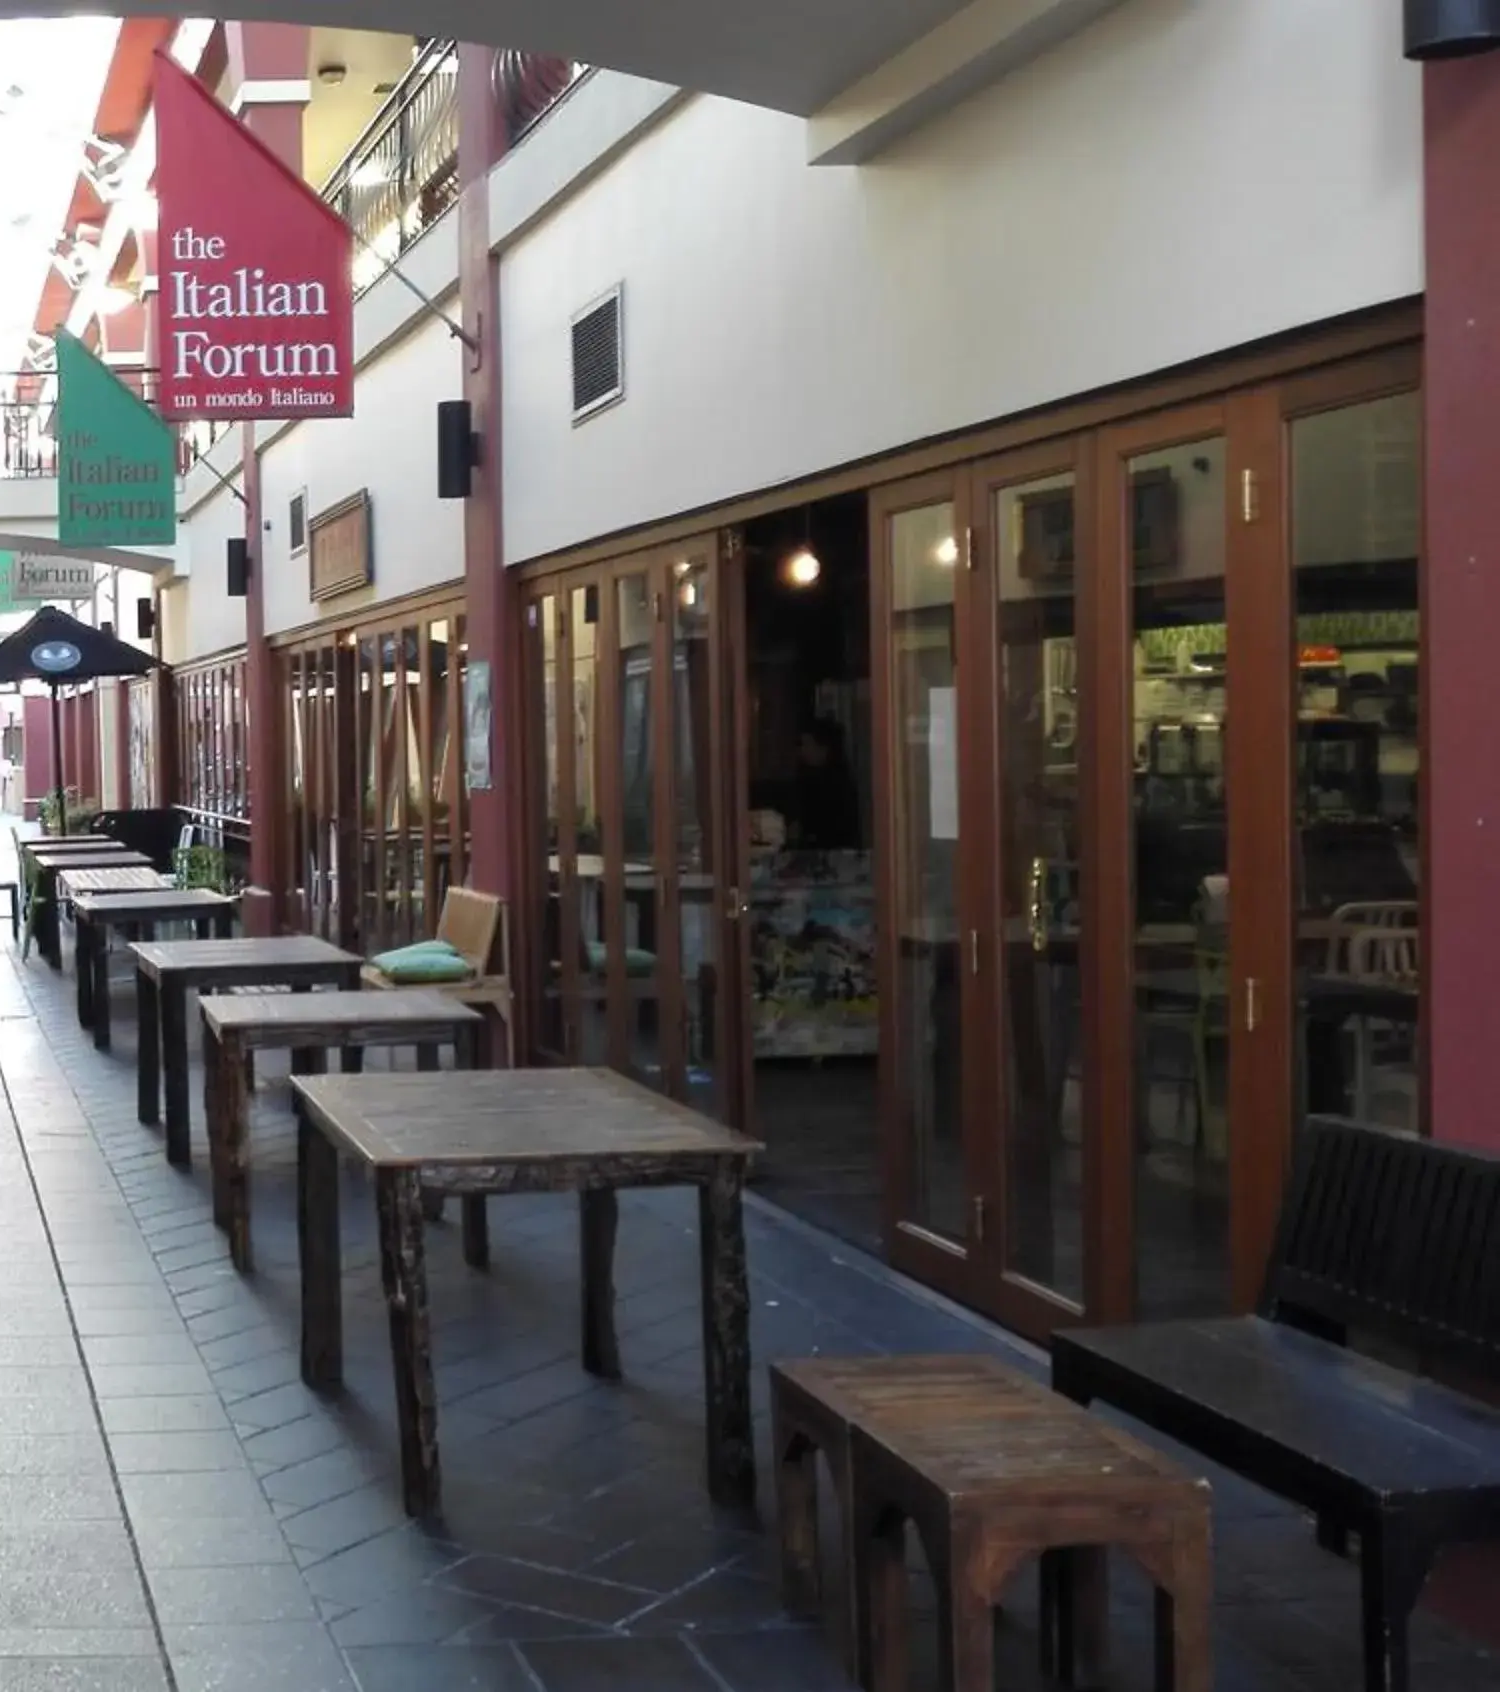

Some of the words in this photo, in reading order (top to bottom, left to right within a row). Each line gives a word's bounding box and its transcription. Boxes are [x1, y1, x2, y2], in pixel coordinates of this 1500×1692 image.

[172, 227, 226, 260] the
[171, 267, 330, 319] Italian
[172, 331, 340, 380] Forum
[174, 391, 198, 408] un
[205, 388, 263, 407] mondo
[270, 387, 335, 406] Italiano
[68, 455, 159, 485] Italian
[68, 492, 167, 521] Forum
[20, 560, 90, 583] Forum
